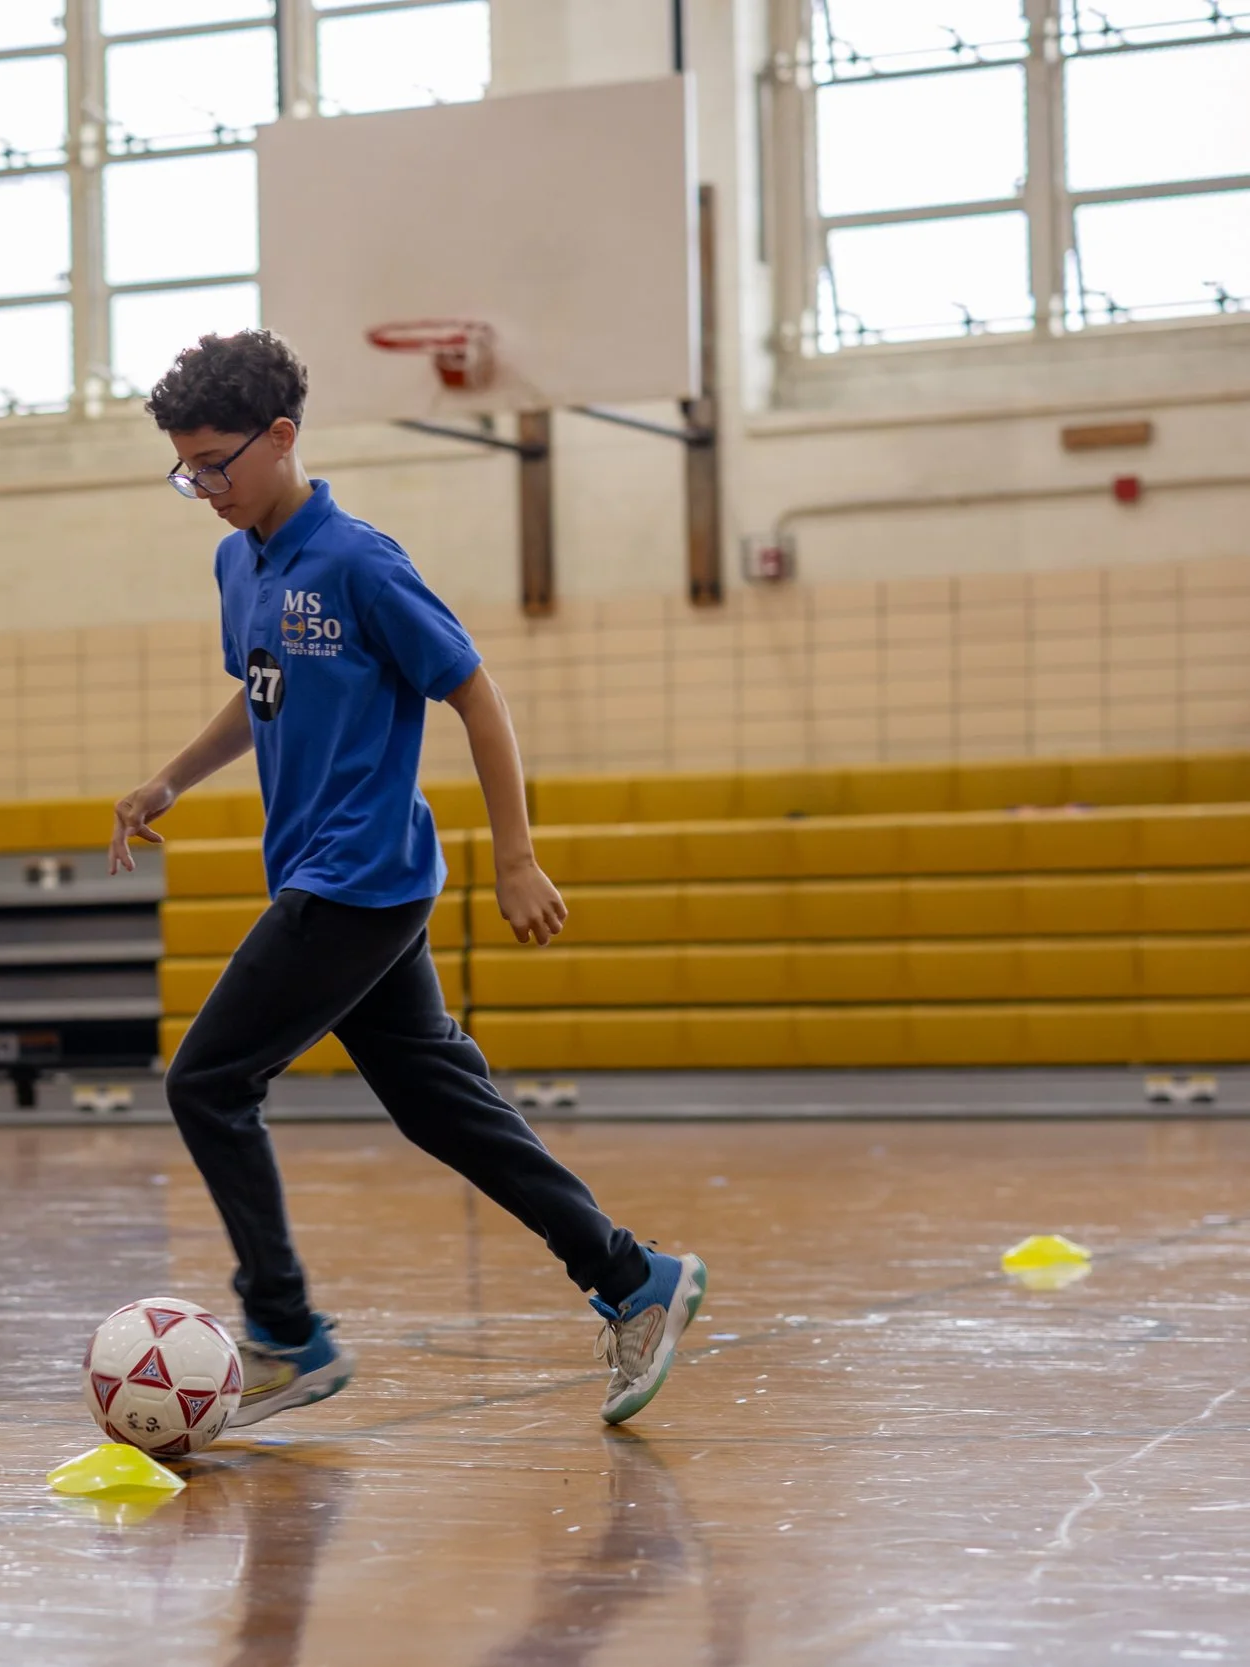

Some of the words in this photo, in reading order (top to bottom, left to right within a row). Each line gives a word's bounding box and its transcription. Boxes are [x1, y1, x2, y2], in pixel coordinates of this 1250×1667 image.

[282, 589, 322, 615] MS
[307, 617, 341, 640] 50
[308, 642, 321, 650] OF
[324, 643, 343, 651] THE
[249, 665, 281, 703] 27
